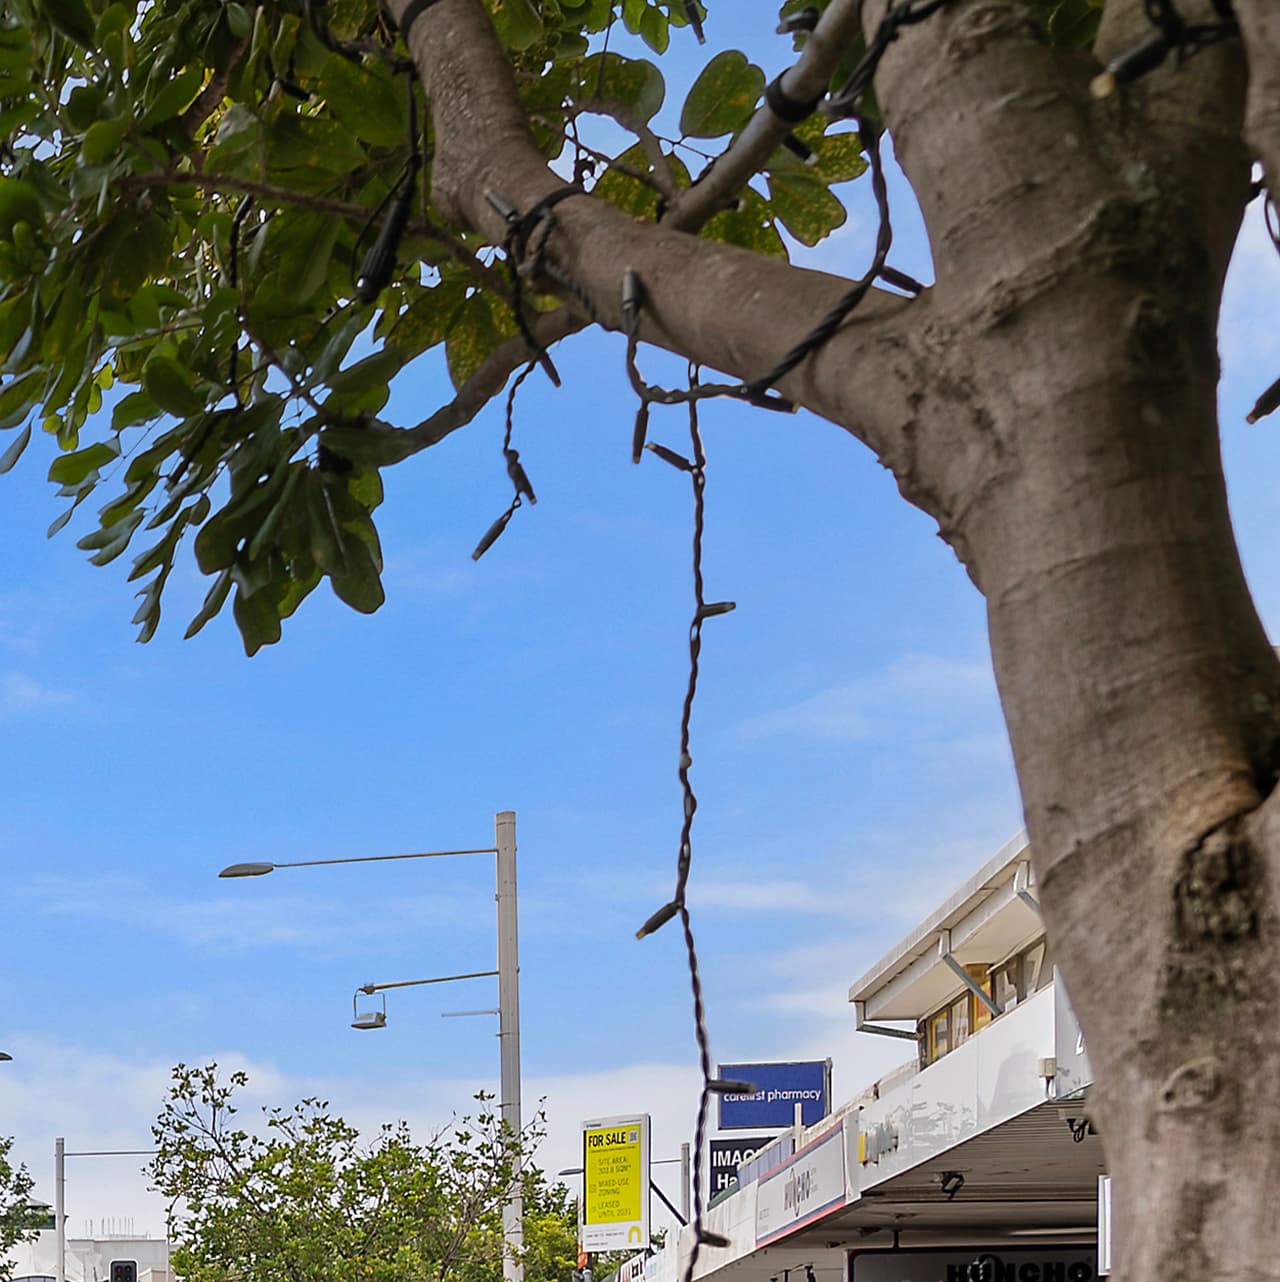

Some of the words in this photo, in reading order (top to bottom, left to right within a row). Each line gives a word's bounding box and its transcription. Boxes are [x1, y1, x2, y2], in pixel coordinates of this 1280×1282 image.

[768, 1089, 821, 1103] pharmacy
[588, 1135, 604, 1148] FOR
[605, 1131, 626, 1145] SALE
